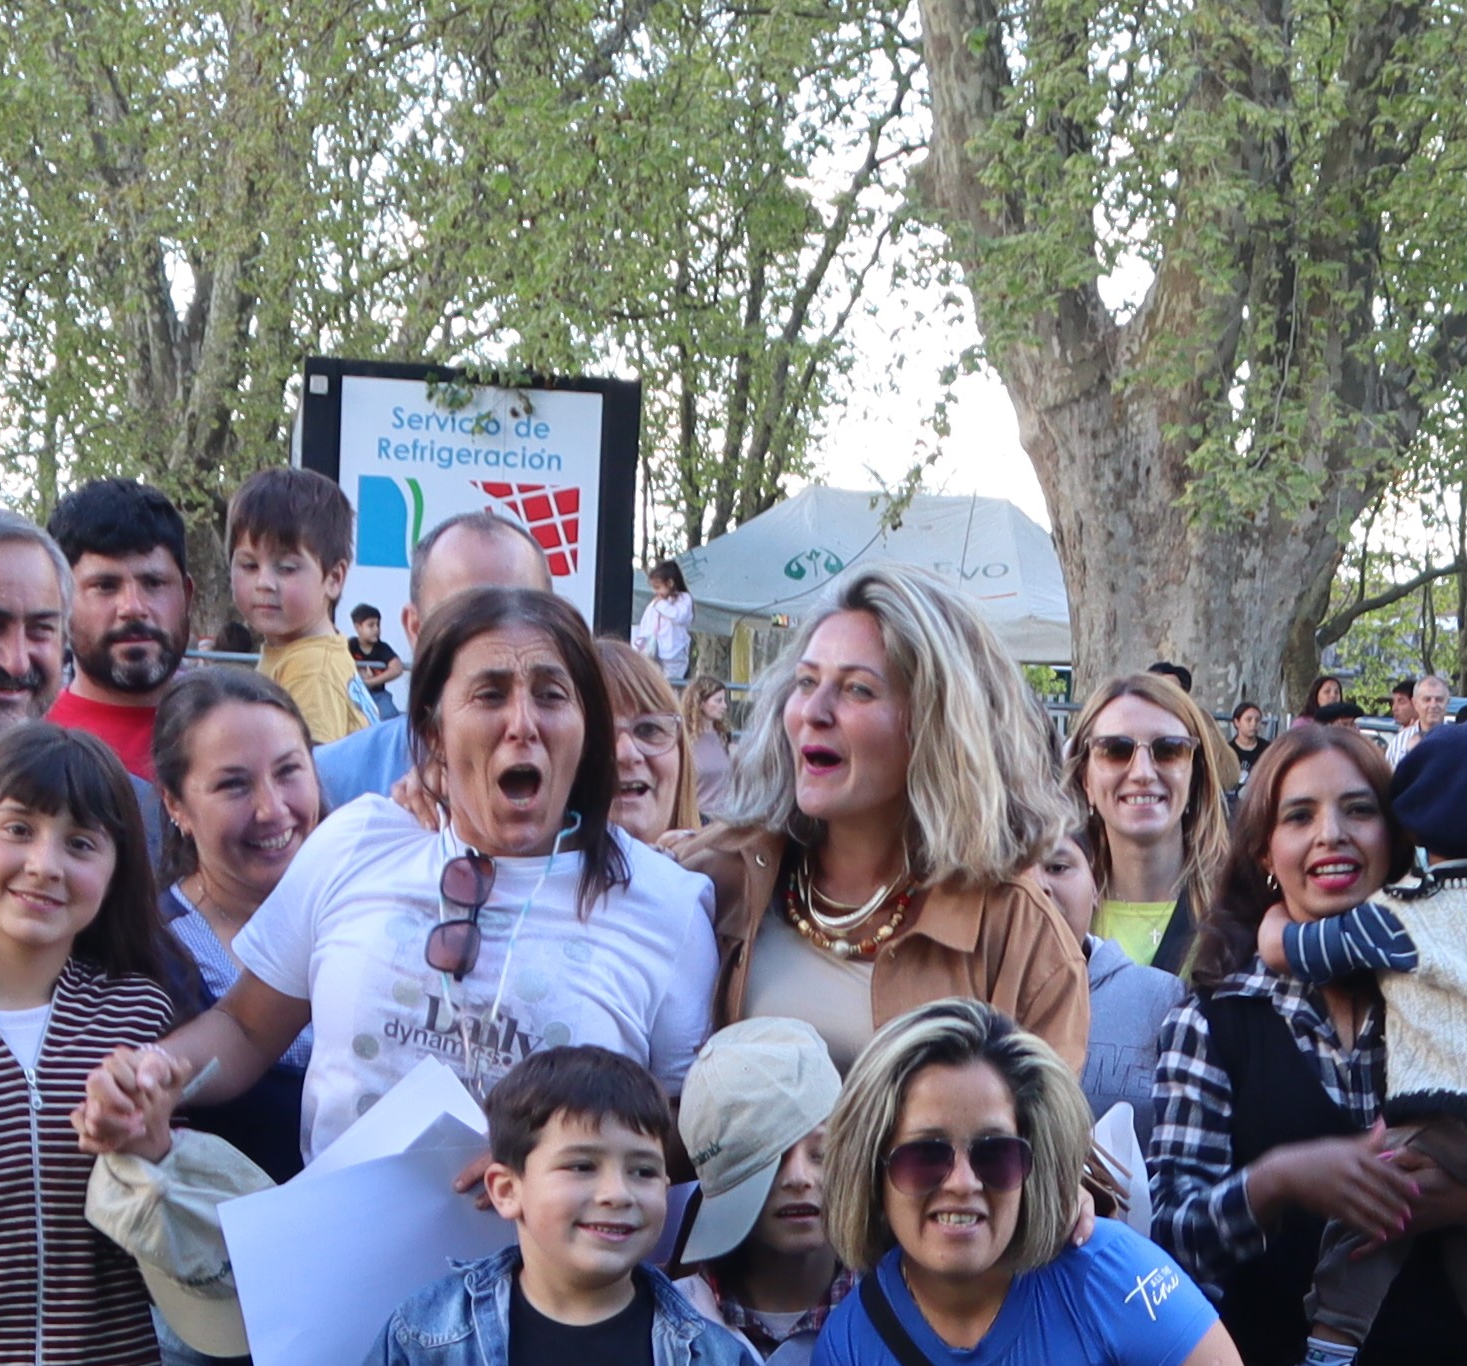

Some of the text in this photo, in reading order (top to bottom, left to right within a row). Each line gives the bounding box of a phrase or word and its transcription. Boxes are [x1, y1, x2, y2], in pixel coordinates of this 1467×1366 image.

[514, 416, 550, 439] de
[377, 437, 562, 471] Refrigeración
[1124, 1268, 1179, 1321] Time
